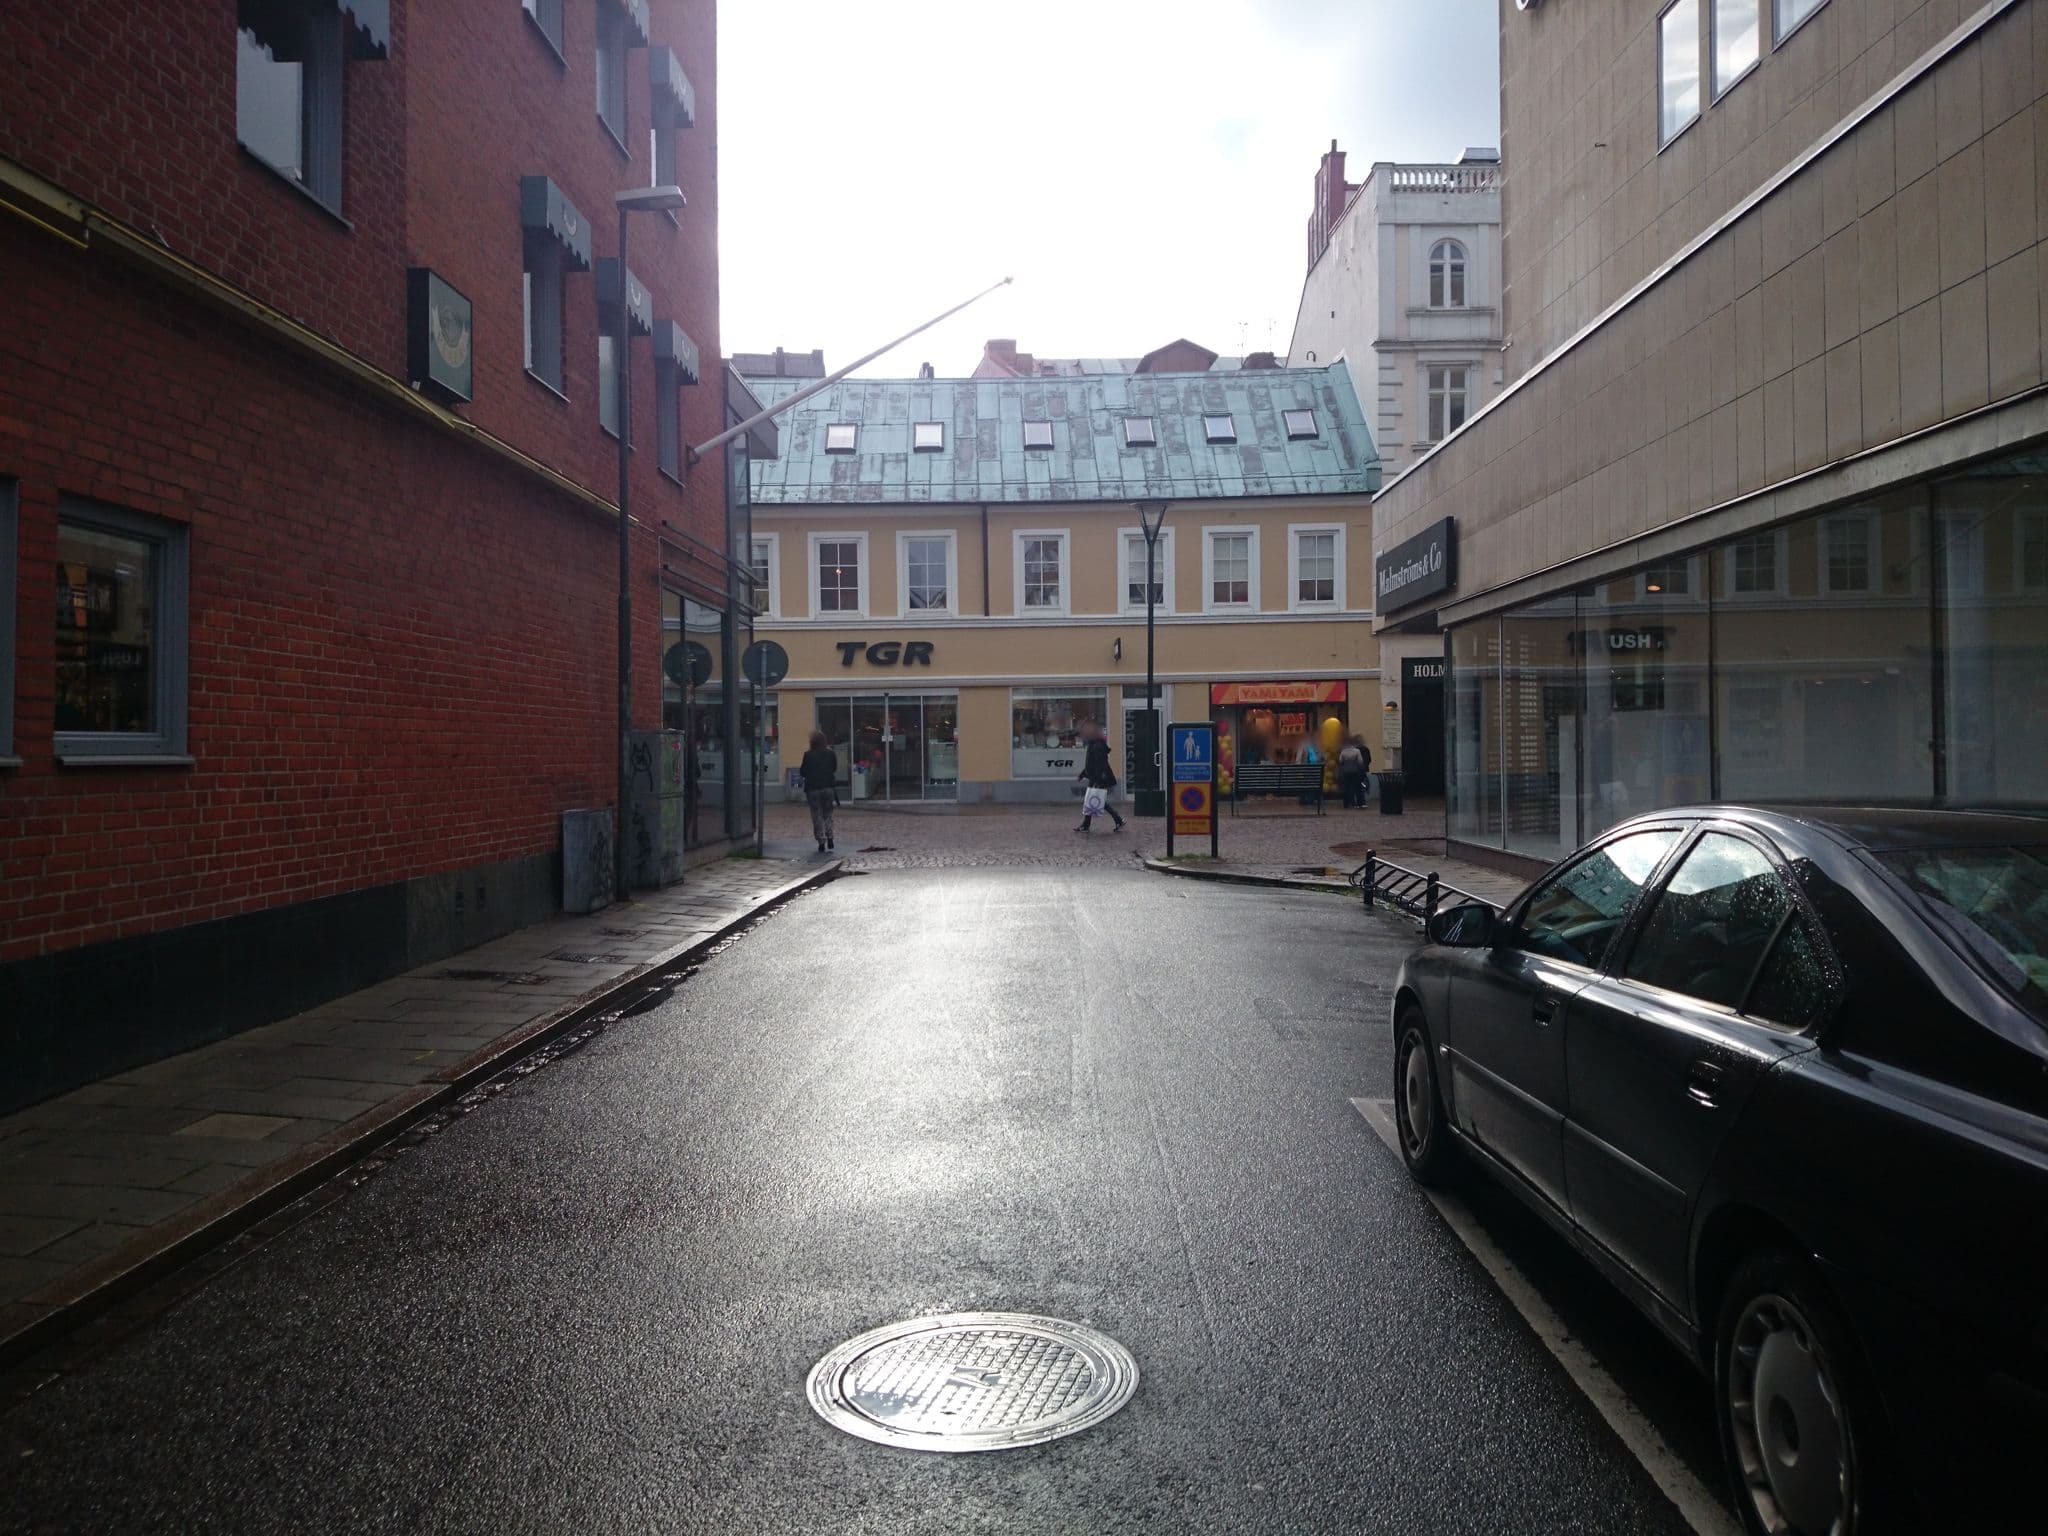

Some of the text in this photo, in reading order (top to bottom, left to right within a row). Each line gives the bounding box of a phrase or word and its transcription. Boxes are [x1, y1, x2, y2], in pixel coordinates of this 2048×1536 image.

[1379, 542, 1442, 597] Malmströms & Co
[836, 641, 934, 667] TGR
[1242, 687, 1315, 699] YAMI YAMI
[1046, 759, 1074, 768] TGR
